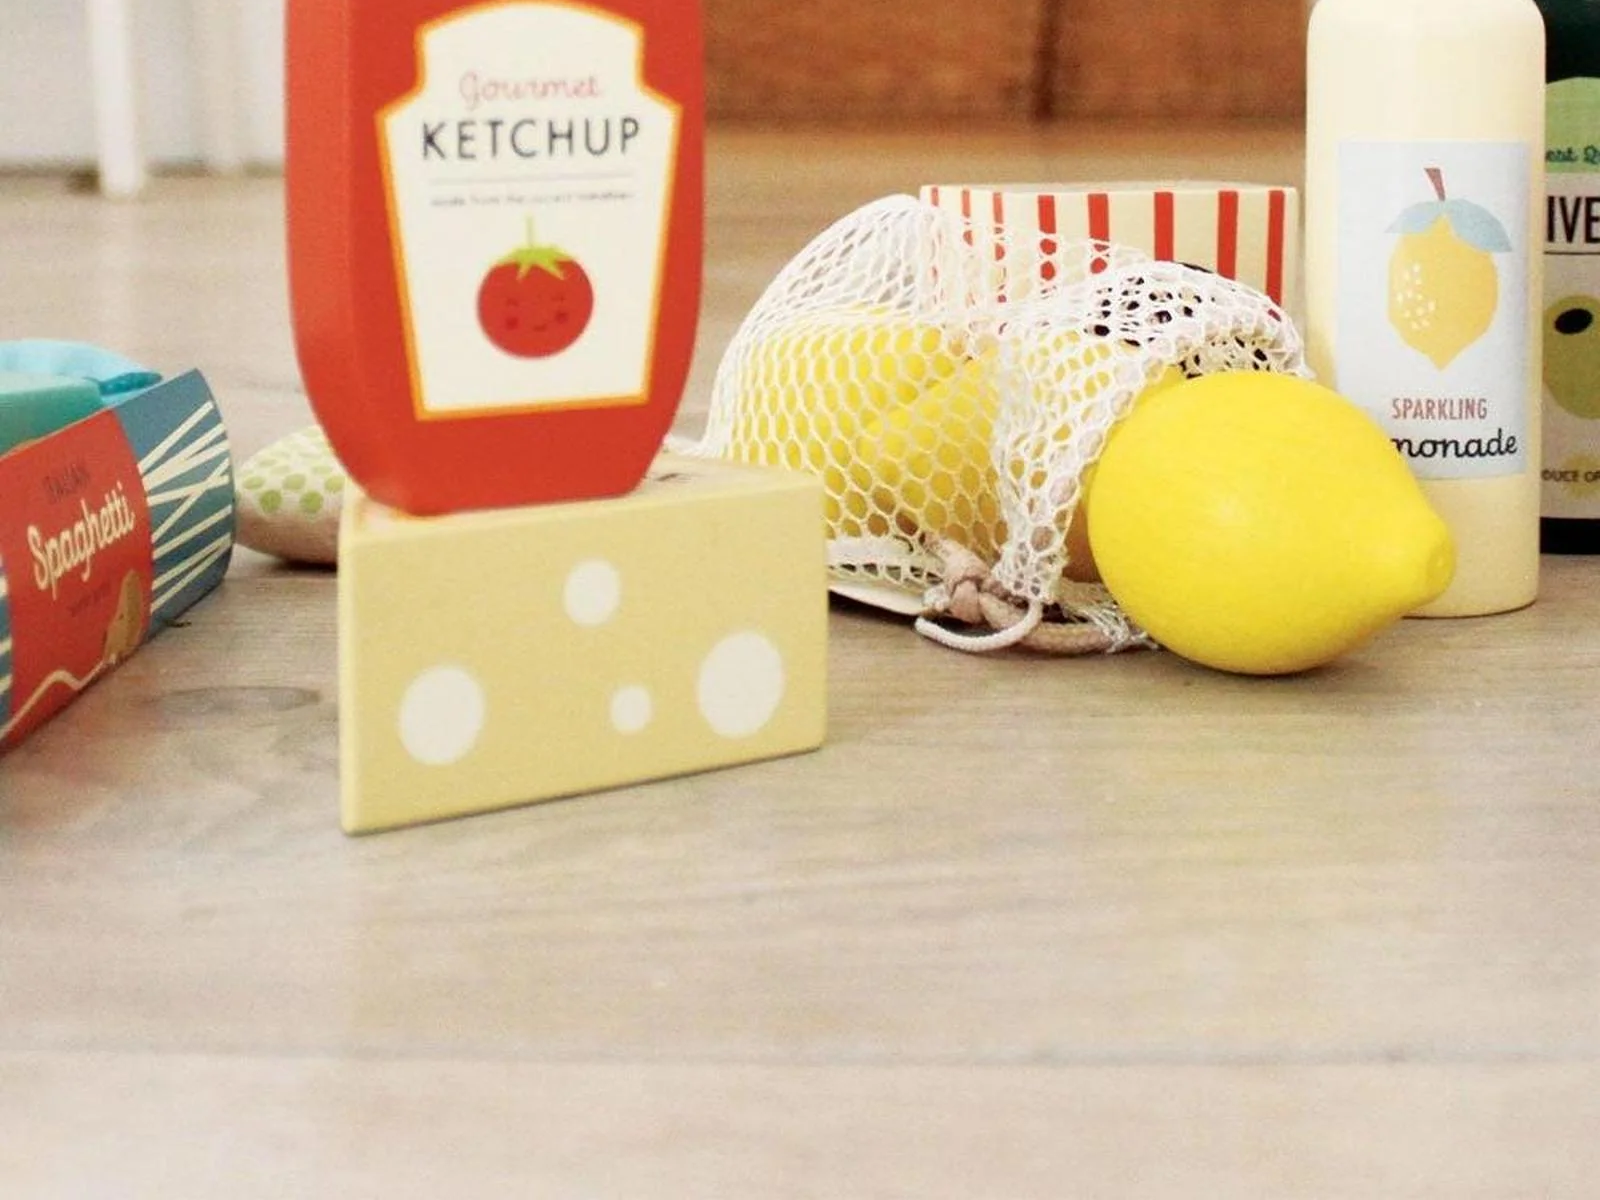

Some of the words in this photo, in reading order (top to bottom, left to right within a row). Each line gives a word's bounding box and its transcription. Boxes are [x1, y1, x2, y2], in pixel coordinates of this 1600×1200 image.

[459, 71, 601, 111] Gourmet
[421, 116, 640, 160] KETCHUP
[1547, 196, 1600, 243] IVE
[1391, 398, 1488, 420] SPARKLING
[27, 480, 135, 601] Spaghetti
